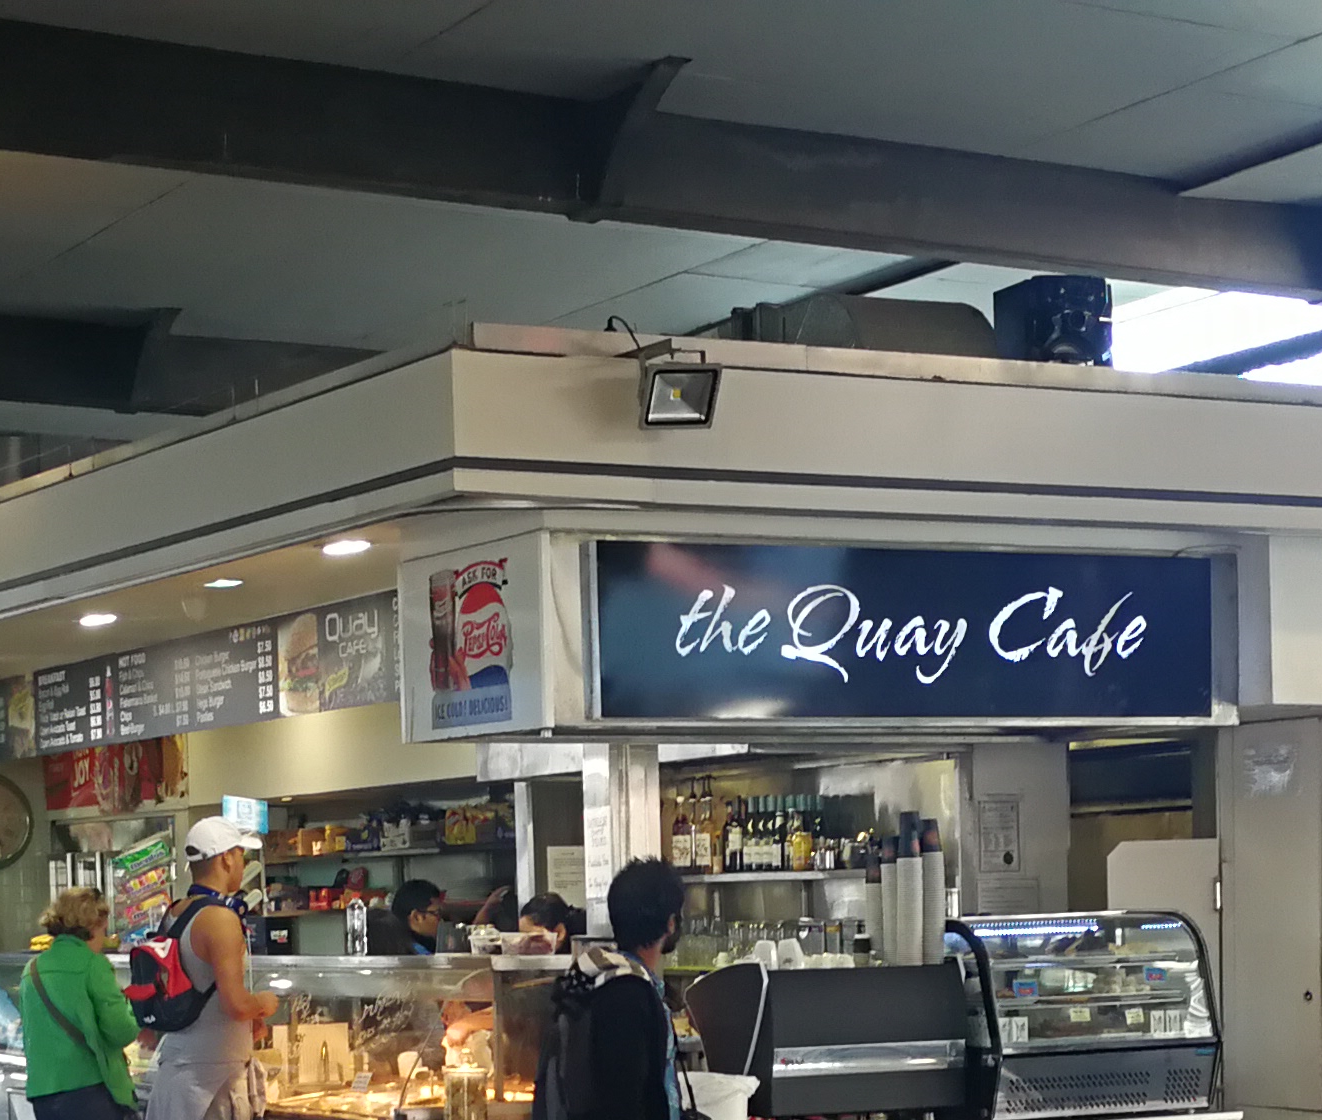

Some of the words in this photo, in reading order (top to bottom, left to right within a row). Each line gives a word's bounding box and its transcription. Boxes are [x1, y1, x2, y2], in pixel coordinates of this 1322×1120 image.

[461, 570, 478, 587] ASK
[480, 567, 497, 581] FOR
[325, 609, 378, 643] Quay
[675, 584, 772, 658] the
[780, 584, 968, 684] Quay
[988, 586, 1148, 677] Cafe
[339, 638, 367, 658] CAFE
[73, 757, 90, 788] JOY
